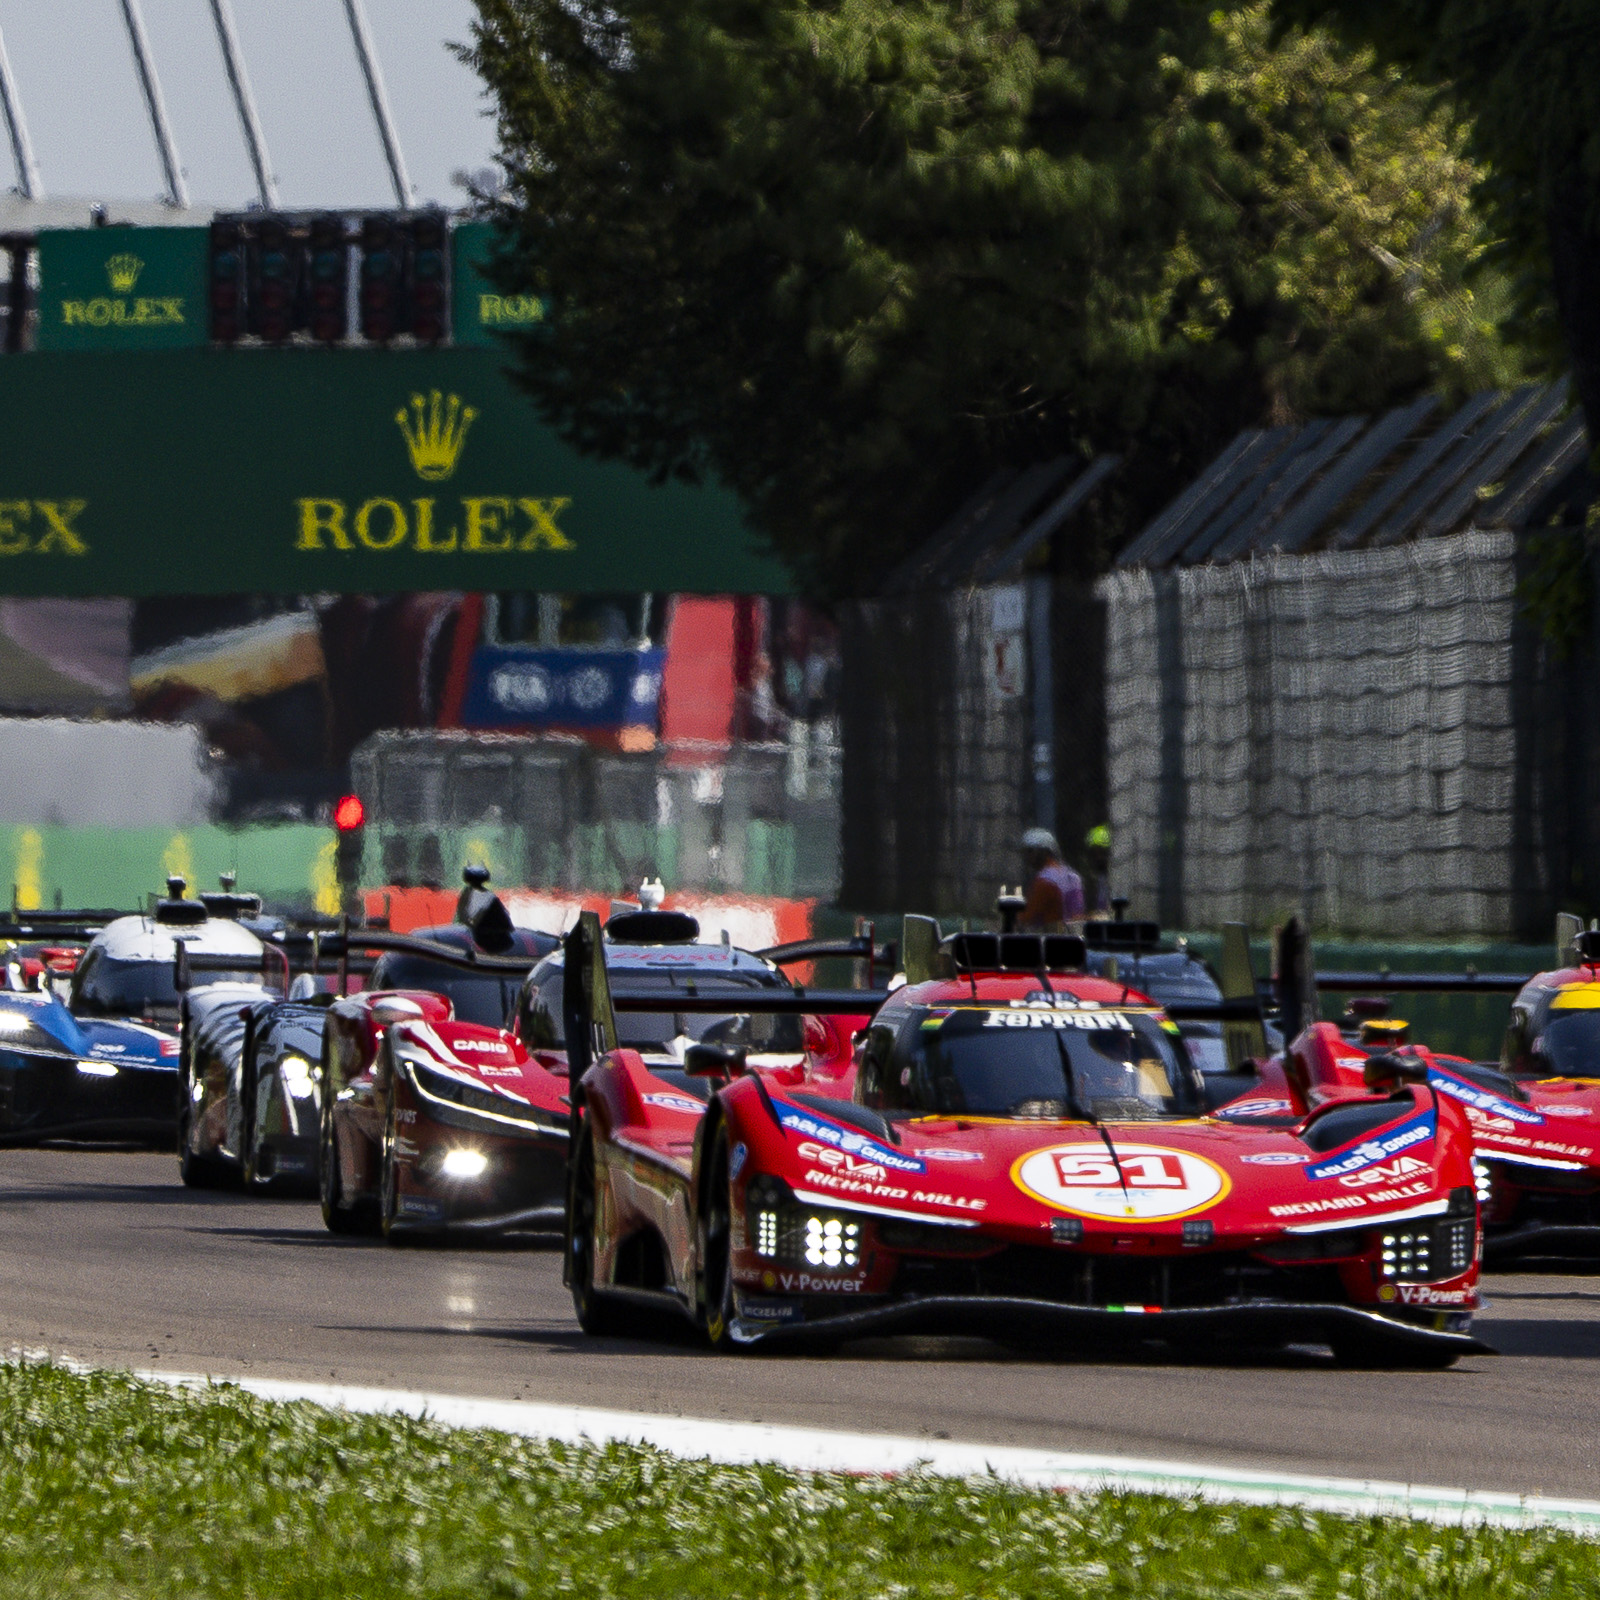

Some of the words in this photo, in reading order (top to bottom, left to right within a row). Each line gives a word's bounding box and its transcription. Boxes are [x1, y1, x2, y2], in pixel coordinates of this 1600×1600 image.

[61, 296, 185, 326] ROLEX
[296, 496, 576, 553] ROLEX
[983, 1010, 1135, 1031] Ferrari
[453, 1039, 508, 1054] CASIO
[781, 1114, 842, 1145] ADLER
[861, 1145, 923, 1171] GROUP
[1058, 1135, 1184, 1186] 51
[1313, 1155, 1365, 1179] ADLER
[1382, 1125, 1431, 1153] GROUP
[804, 1168, 909, 1200] RICHARD
[911, 1190, 988, 1210] MILLE
[1268, 1193, 1367, 1217] RICHARD
[1366, 1181, 1432, 1204] MILLE
[779, 1272, 864, 1292] V-Power
[1400, 1286, 1466, 1304] V-Power
